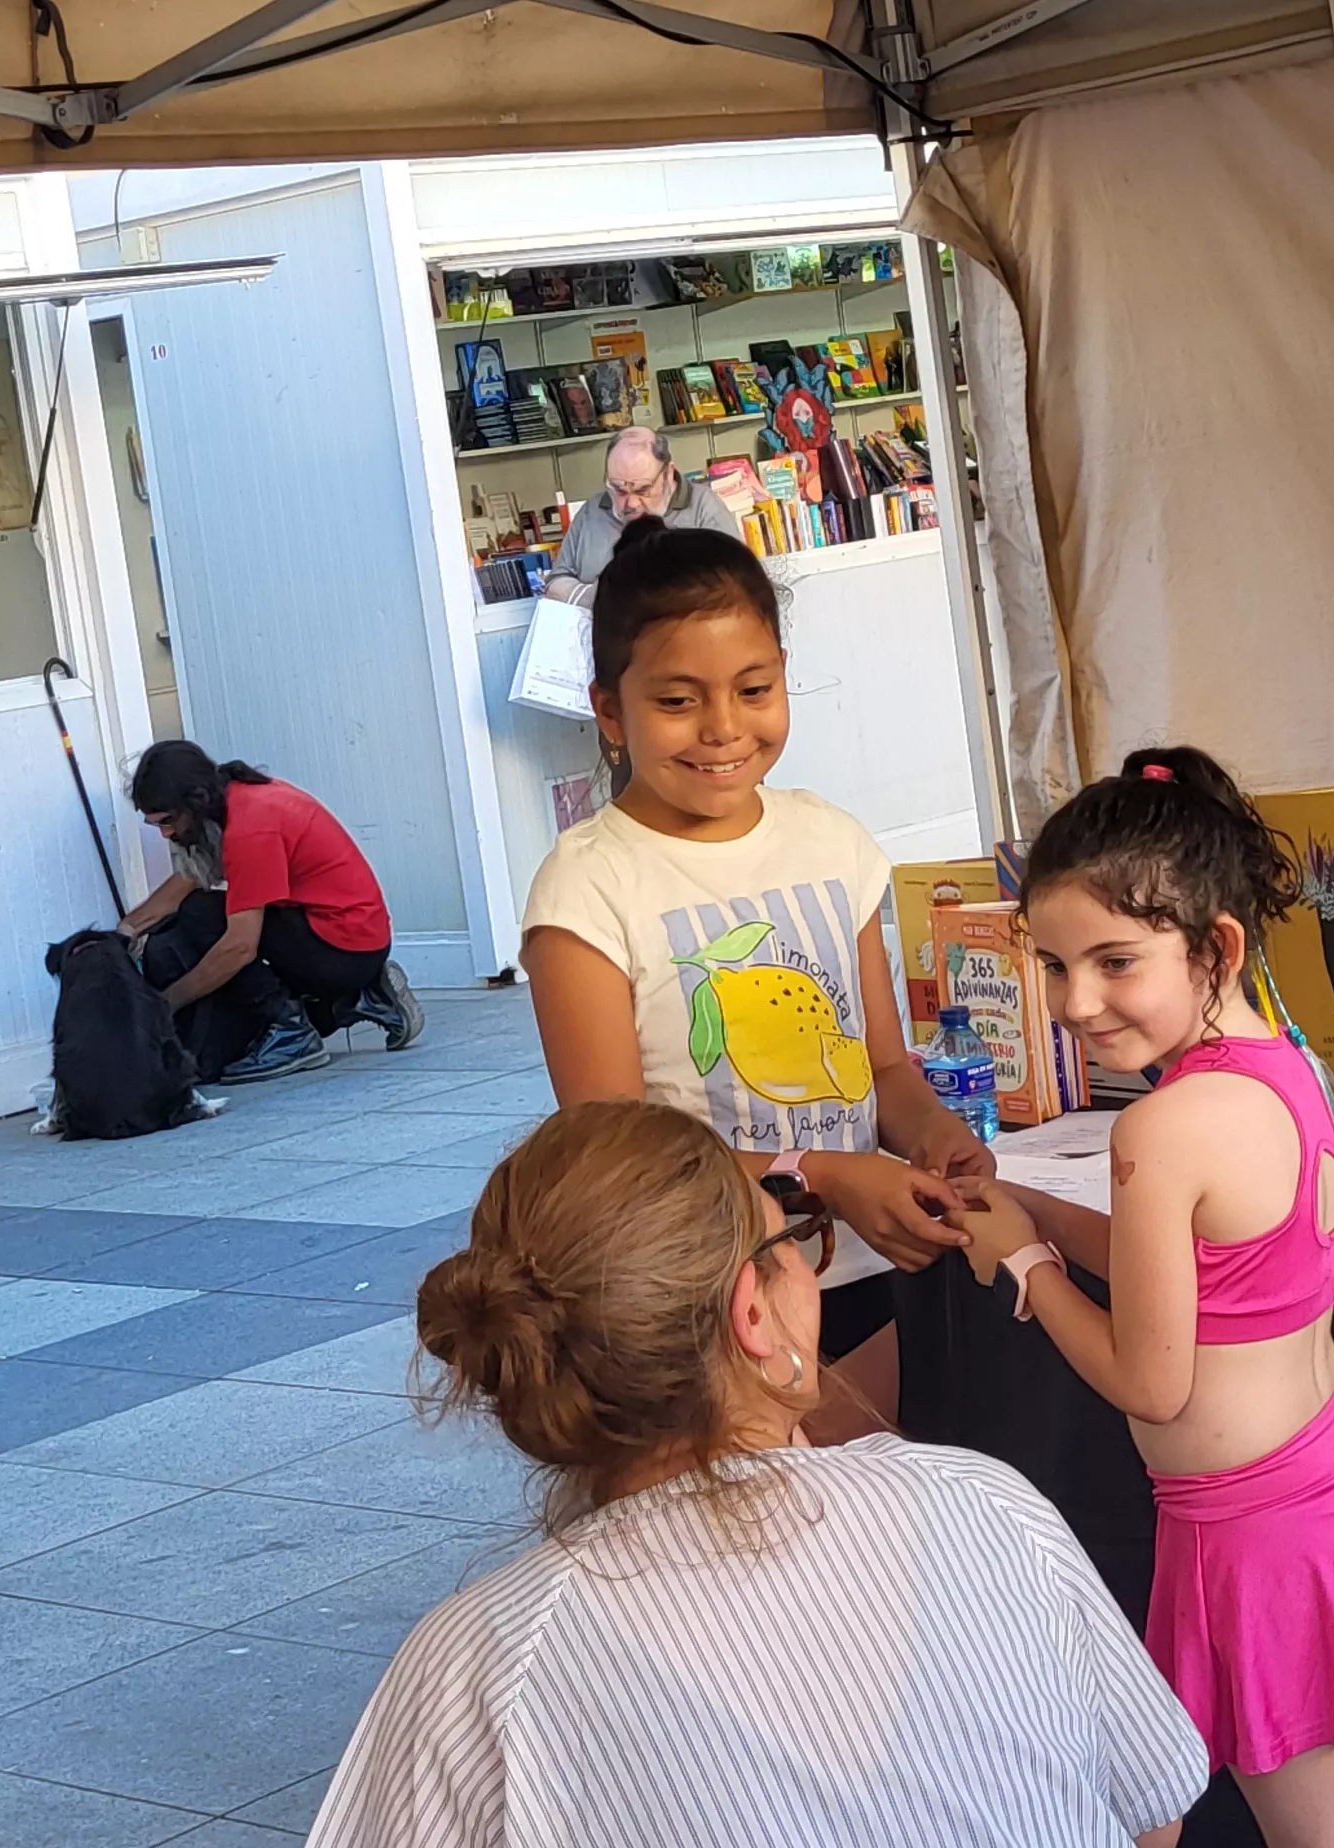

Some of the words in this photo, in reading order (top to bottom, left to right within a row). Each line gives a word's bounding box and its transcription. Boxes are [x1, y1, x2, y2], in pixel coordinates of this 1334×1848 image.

[150, 344, 167, 361] 10
[770, 934, 852, 1022] limonata
[969, 957, 995, 978] 365
[976, 1018, 999, 1037] DÍA
[730, 1121, 781, 1149] per
[787, 1105, 861, 1149] favore
